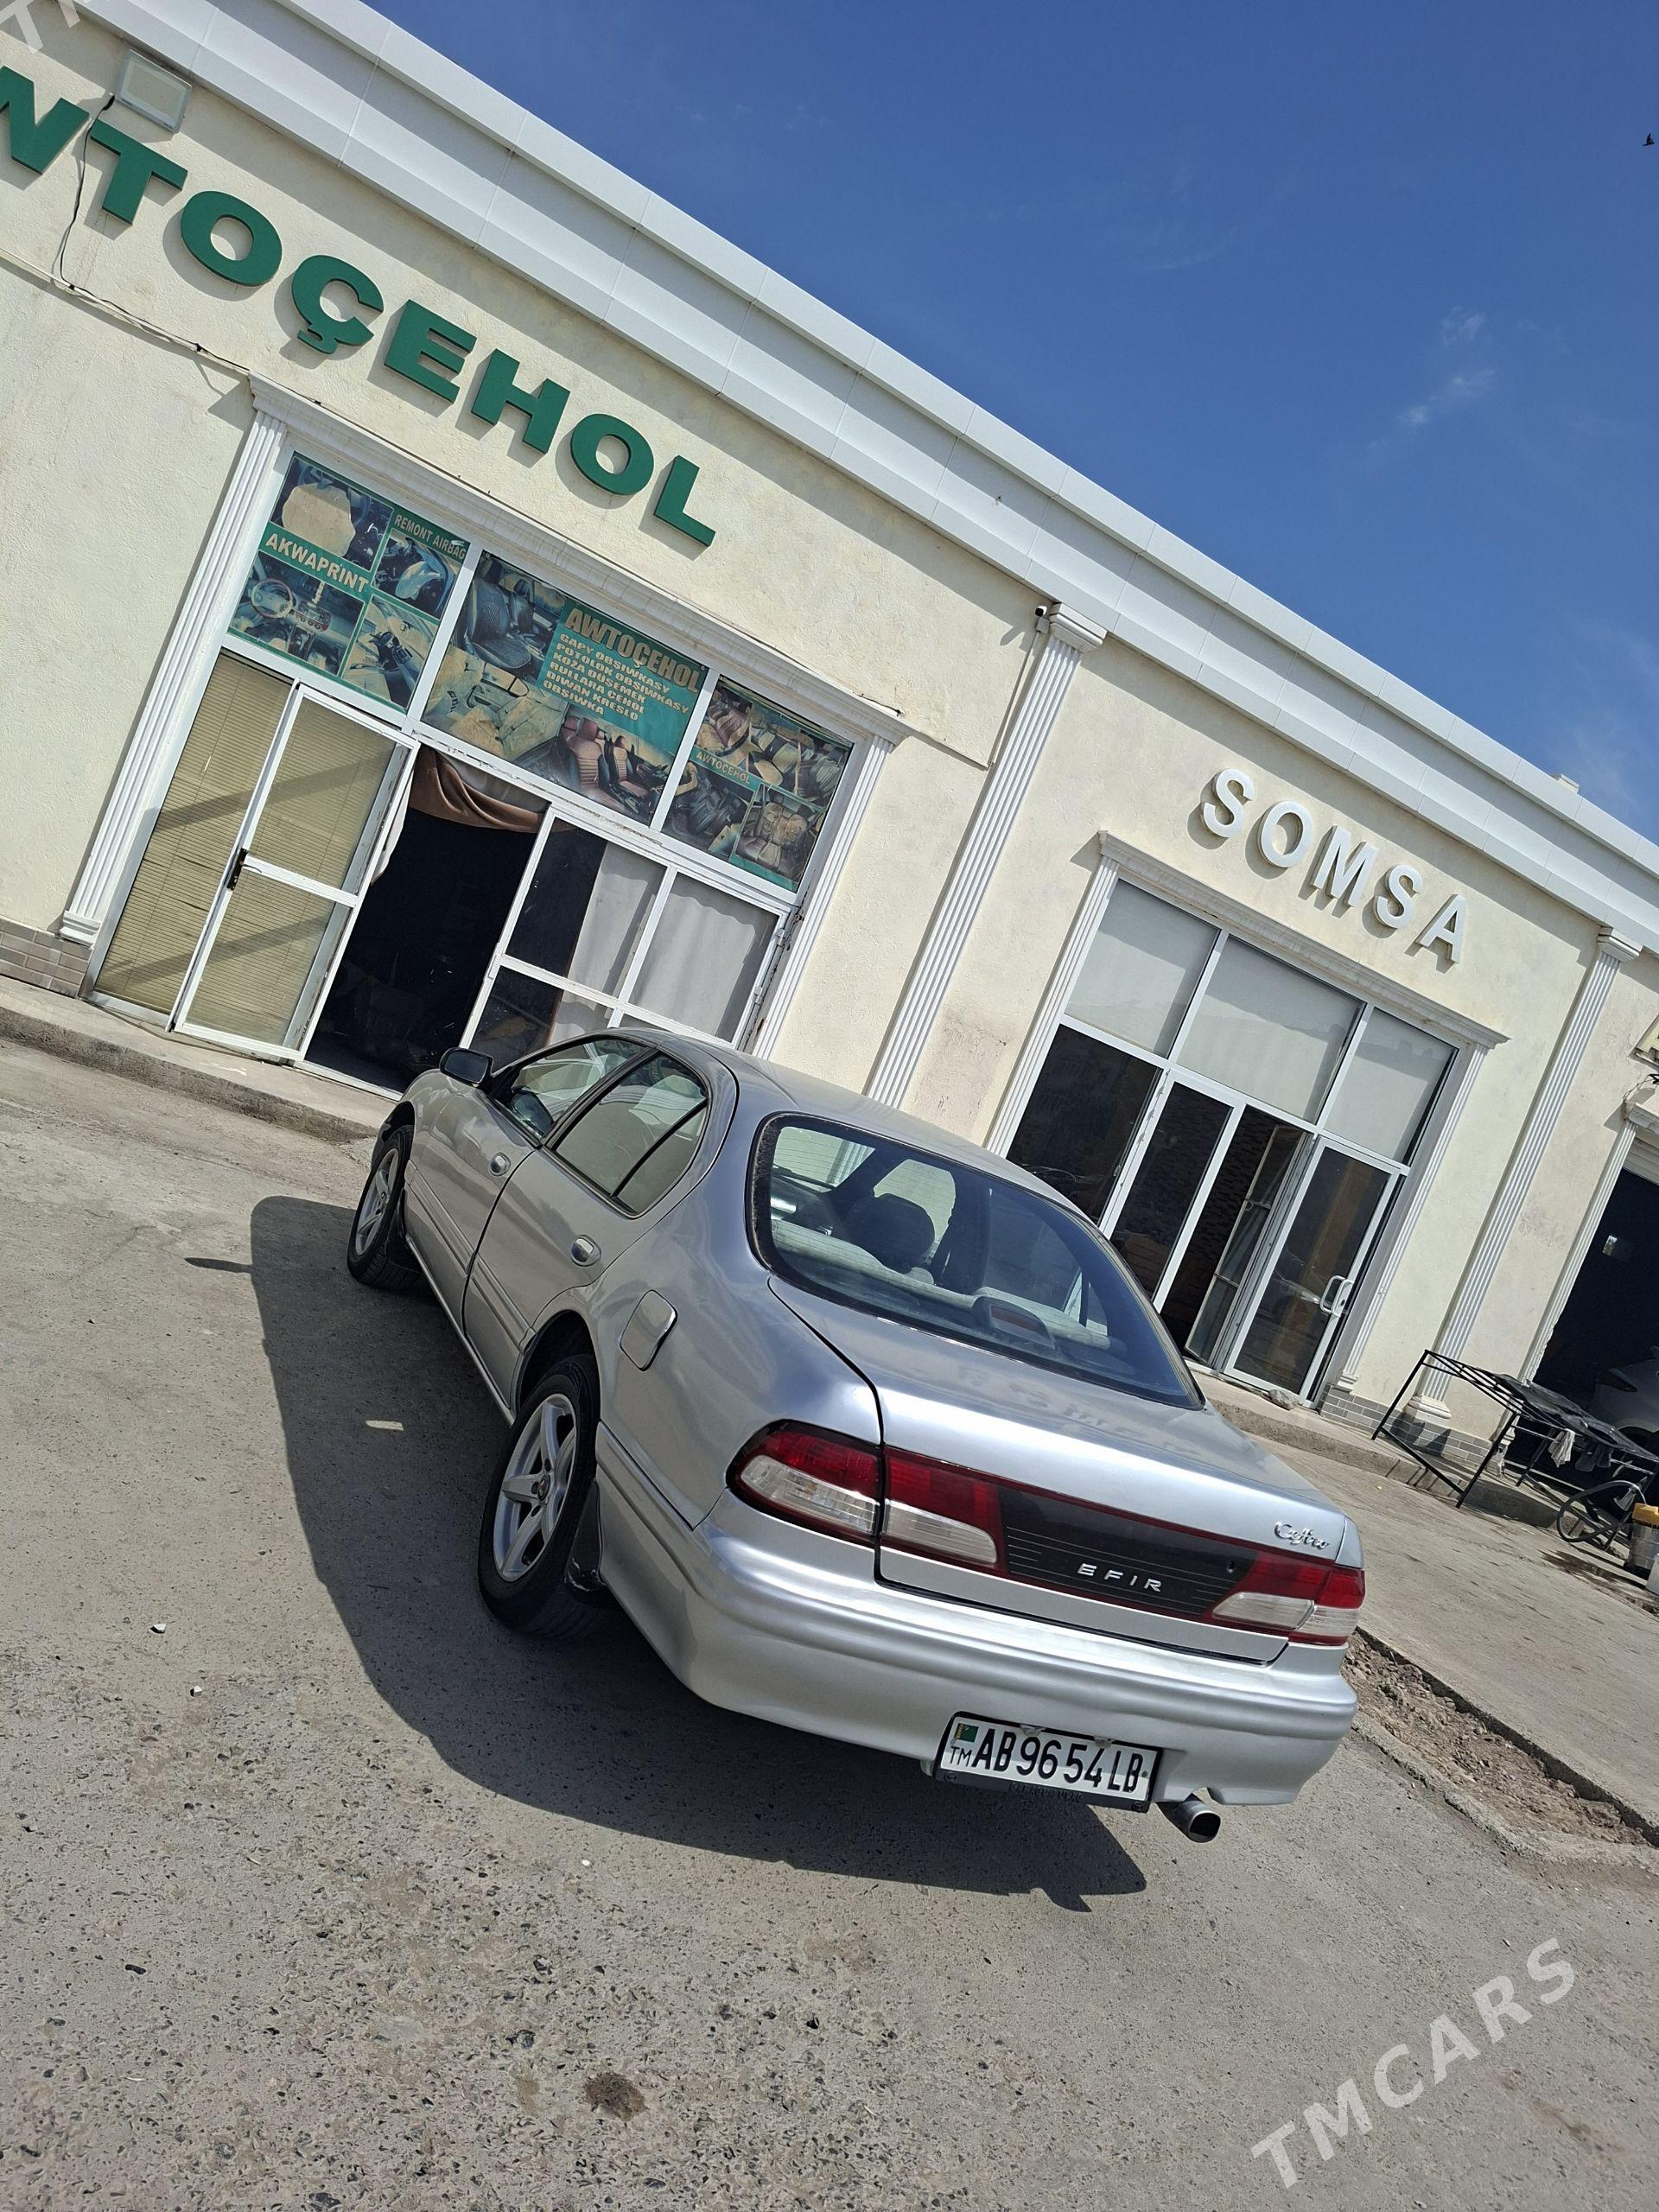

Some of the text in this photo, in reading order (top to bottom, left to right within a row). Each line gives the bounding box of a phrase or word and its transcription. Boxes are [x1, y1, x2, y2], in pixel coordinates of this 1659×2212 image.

[394, 514, 467, 560] REMONT AIRBAG
[264, 532, 369, 593] AKWAPRINT
[556, 644, 612, 676] POTOLOK
[559, 633, 594, 653] GAPY
[564, 608, 701, 693] AWTOÇEHOL
[550, 661, 605, 694] RULLARA
[546, 671, 639, 721] DIWAN KRESLO
[696, 751, 751, 785] AWTOÇEHOL
[1202, 768, 1466, 963] SOMSA
[1077, 1562, 1162, 1592] EFIR
[950, 1745, 973, 1767] TM
